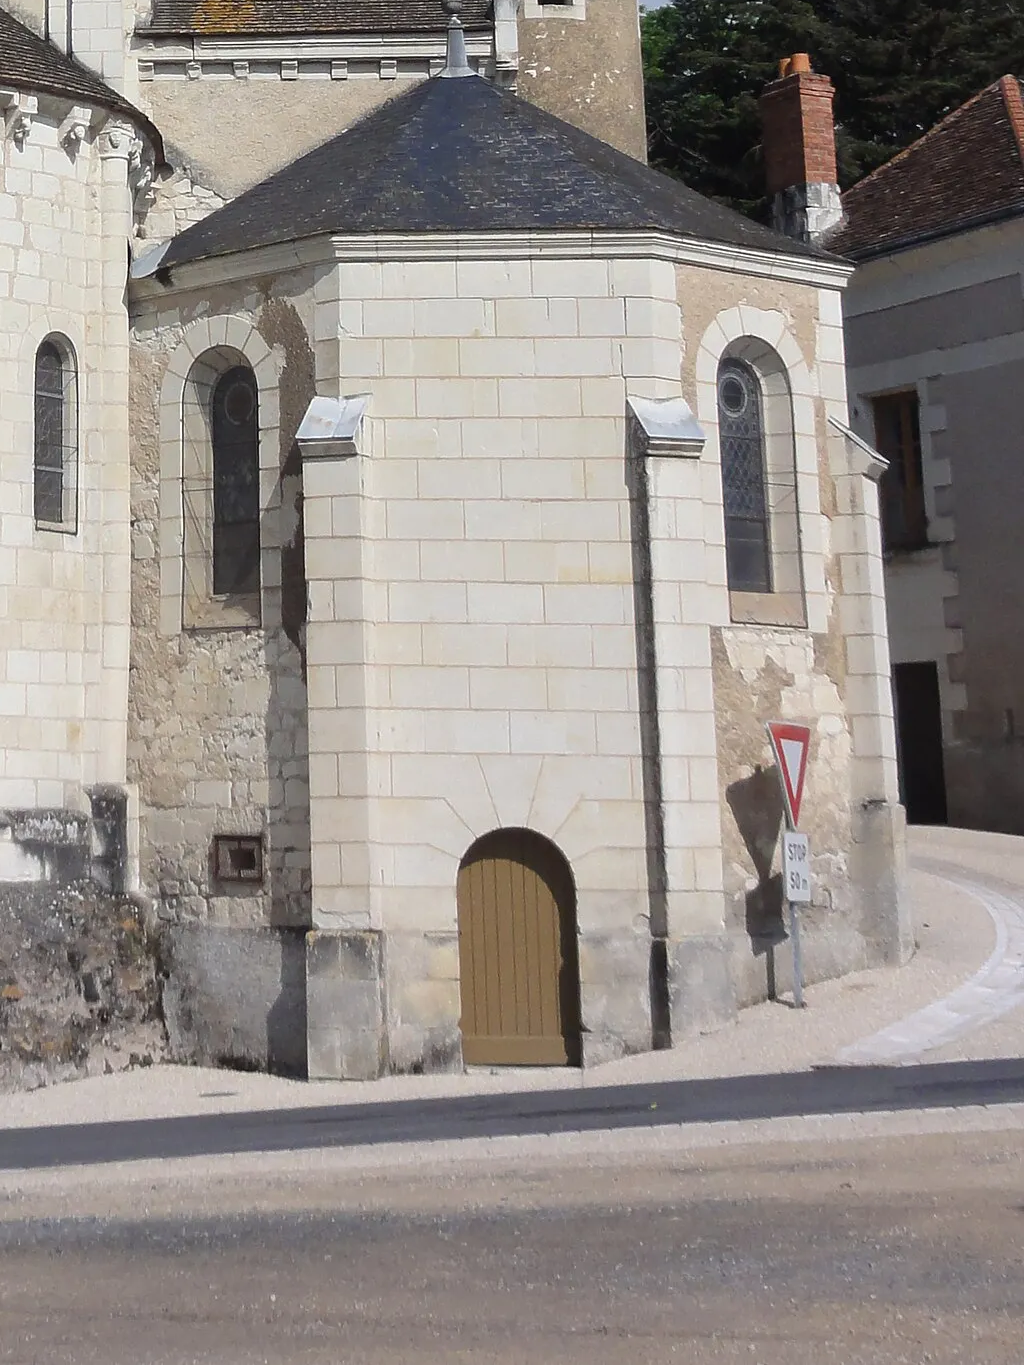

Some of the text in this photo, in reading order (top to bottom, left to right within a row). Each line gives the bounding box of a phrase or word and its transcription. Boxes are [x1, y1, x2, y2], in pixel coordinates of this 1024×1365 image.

[788, 843, 806, 862] STOP
[790, 871, 808, 890] 50 m
